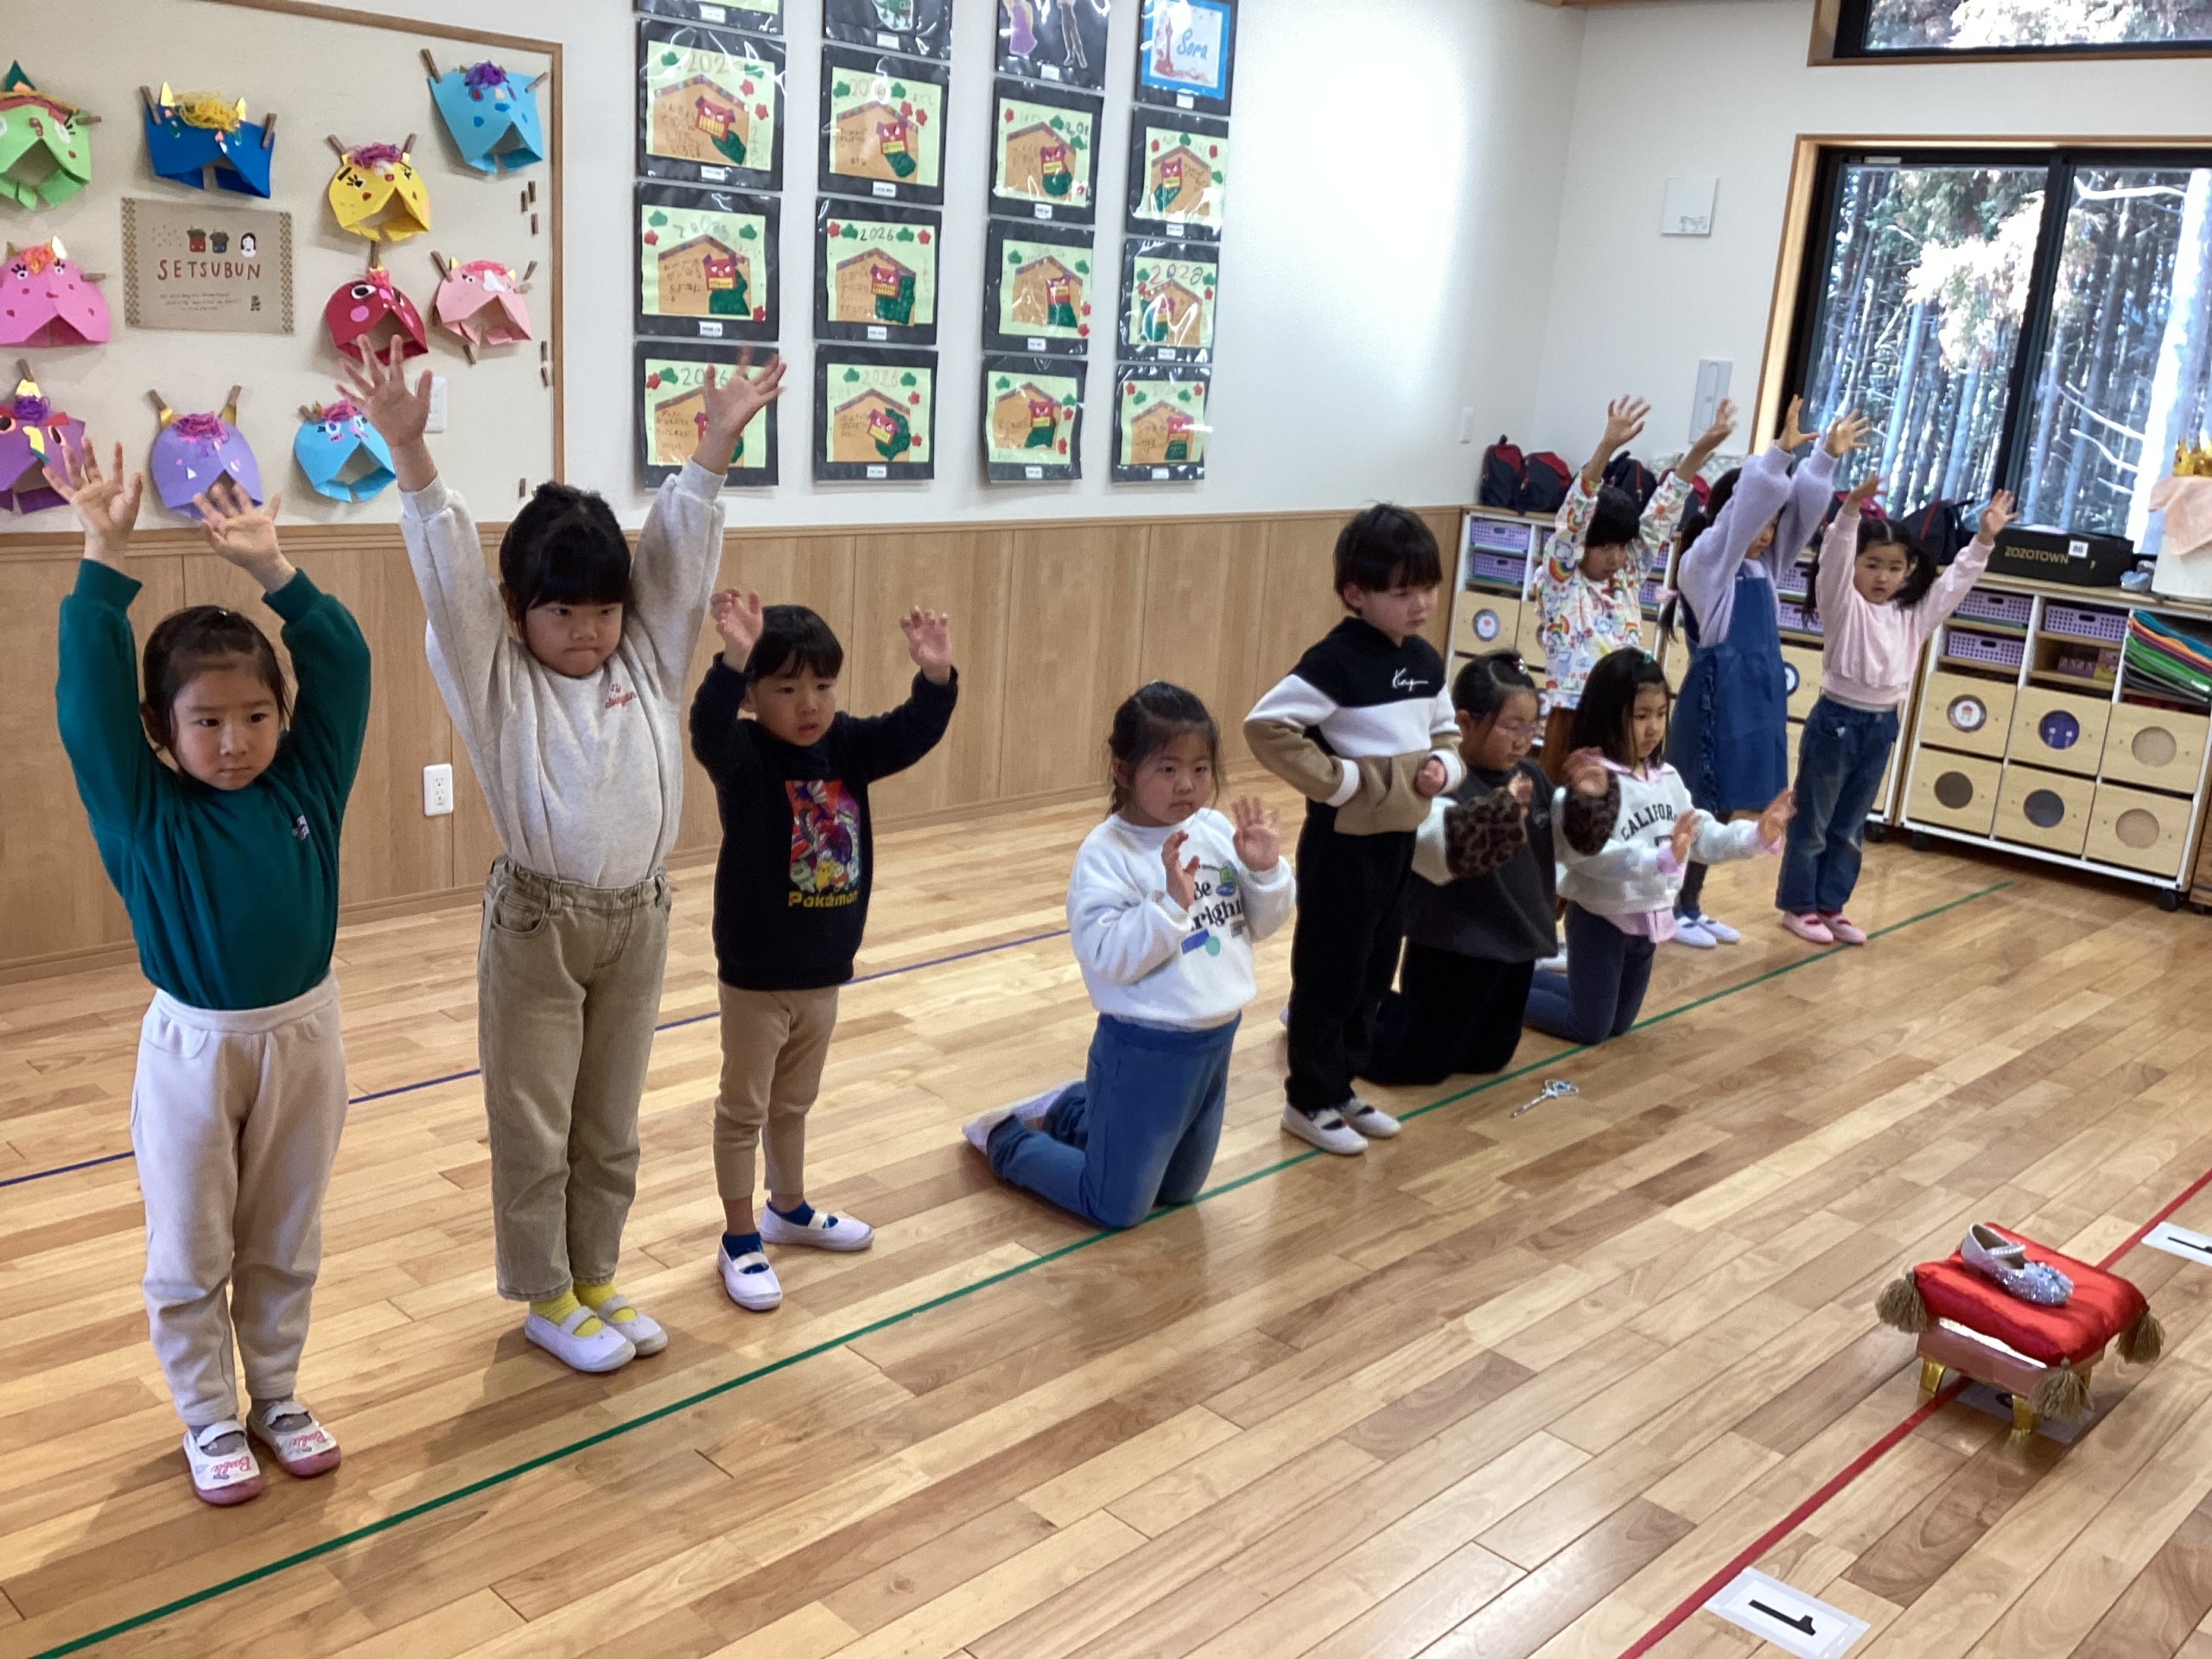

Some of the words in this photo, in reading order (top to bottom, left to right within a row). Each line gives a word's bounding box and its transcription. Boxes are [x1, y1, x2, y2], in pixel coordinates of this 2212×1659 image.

[849, 79, 887, 100] 206
[860, 226, 893, 241] 2026
[157, 259, 261, 281] SETSUBUN
[680, 366, 728, 386] 206
[2004, 546, 2069, 565] ZOZOTOWN
[1621, 803, 1676, 841] CALIFOR
[1191, 899, 1243, 931] right
[1748, 1599, 1817, 1637] 1
